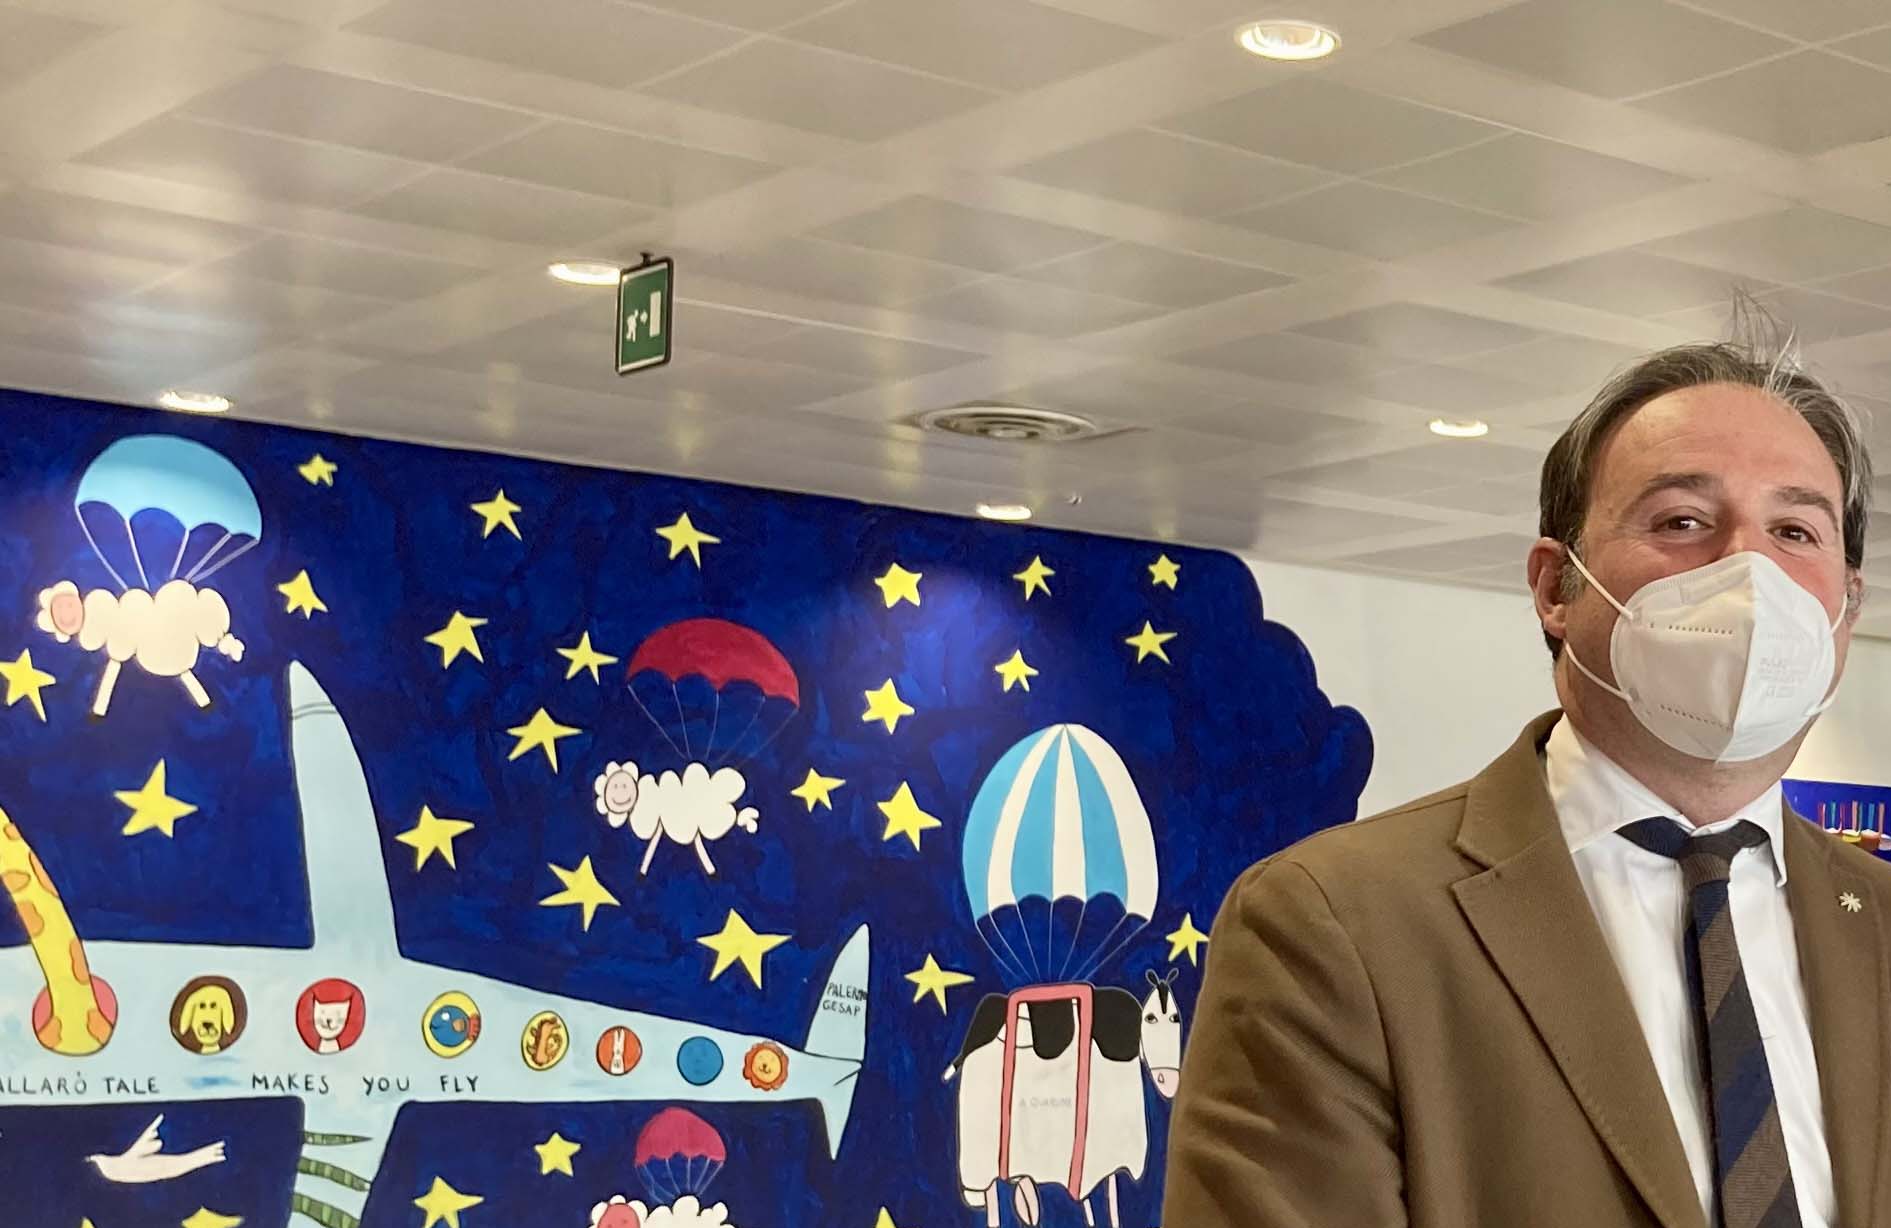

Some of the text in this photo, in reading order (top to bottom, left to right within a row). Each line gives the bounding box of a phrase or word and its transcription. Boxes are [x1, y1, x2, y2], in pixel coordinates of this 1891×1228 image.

[103, 1076, 160, 1095] TALE
[251, 1072, 330, 1095] MAKES
[362, 1076, 411, 1096] YOU
[440, 1075, 480, 1093] FLY
